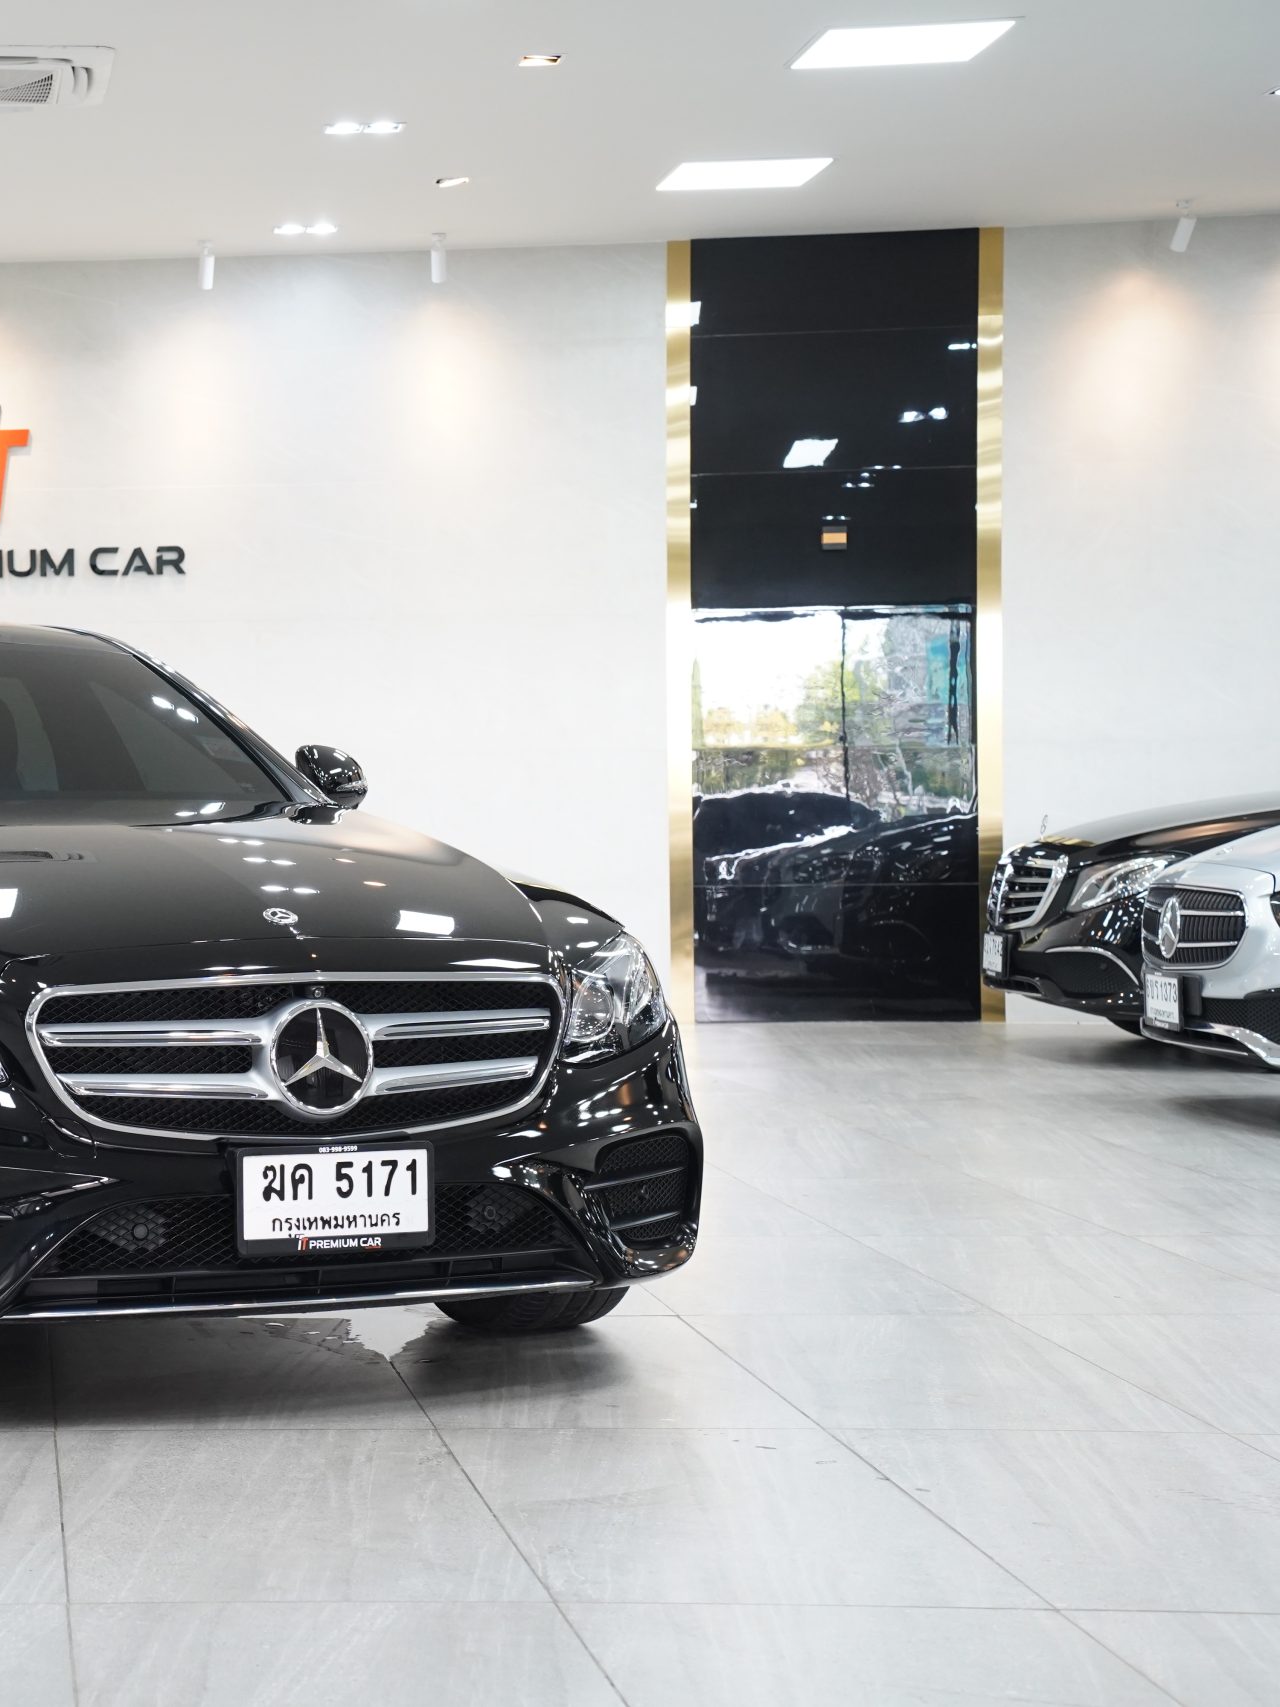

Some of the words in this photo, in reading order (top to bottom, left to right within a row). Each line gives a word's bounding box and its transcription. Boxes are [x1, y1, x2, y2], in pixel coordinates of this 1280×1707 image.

[89, 545, 187, 576] CAR
[335, 1158, 418, 1199] 5171
[271, 1212, 401, 1239] กรุงเทพมหานคร
[309, 1238, 359, 1250] PREMIUM
[360, 1236, 382, 1248] CAR
